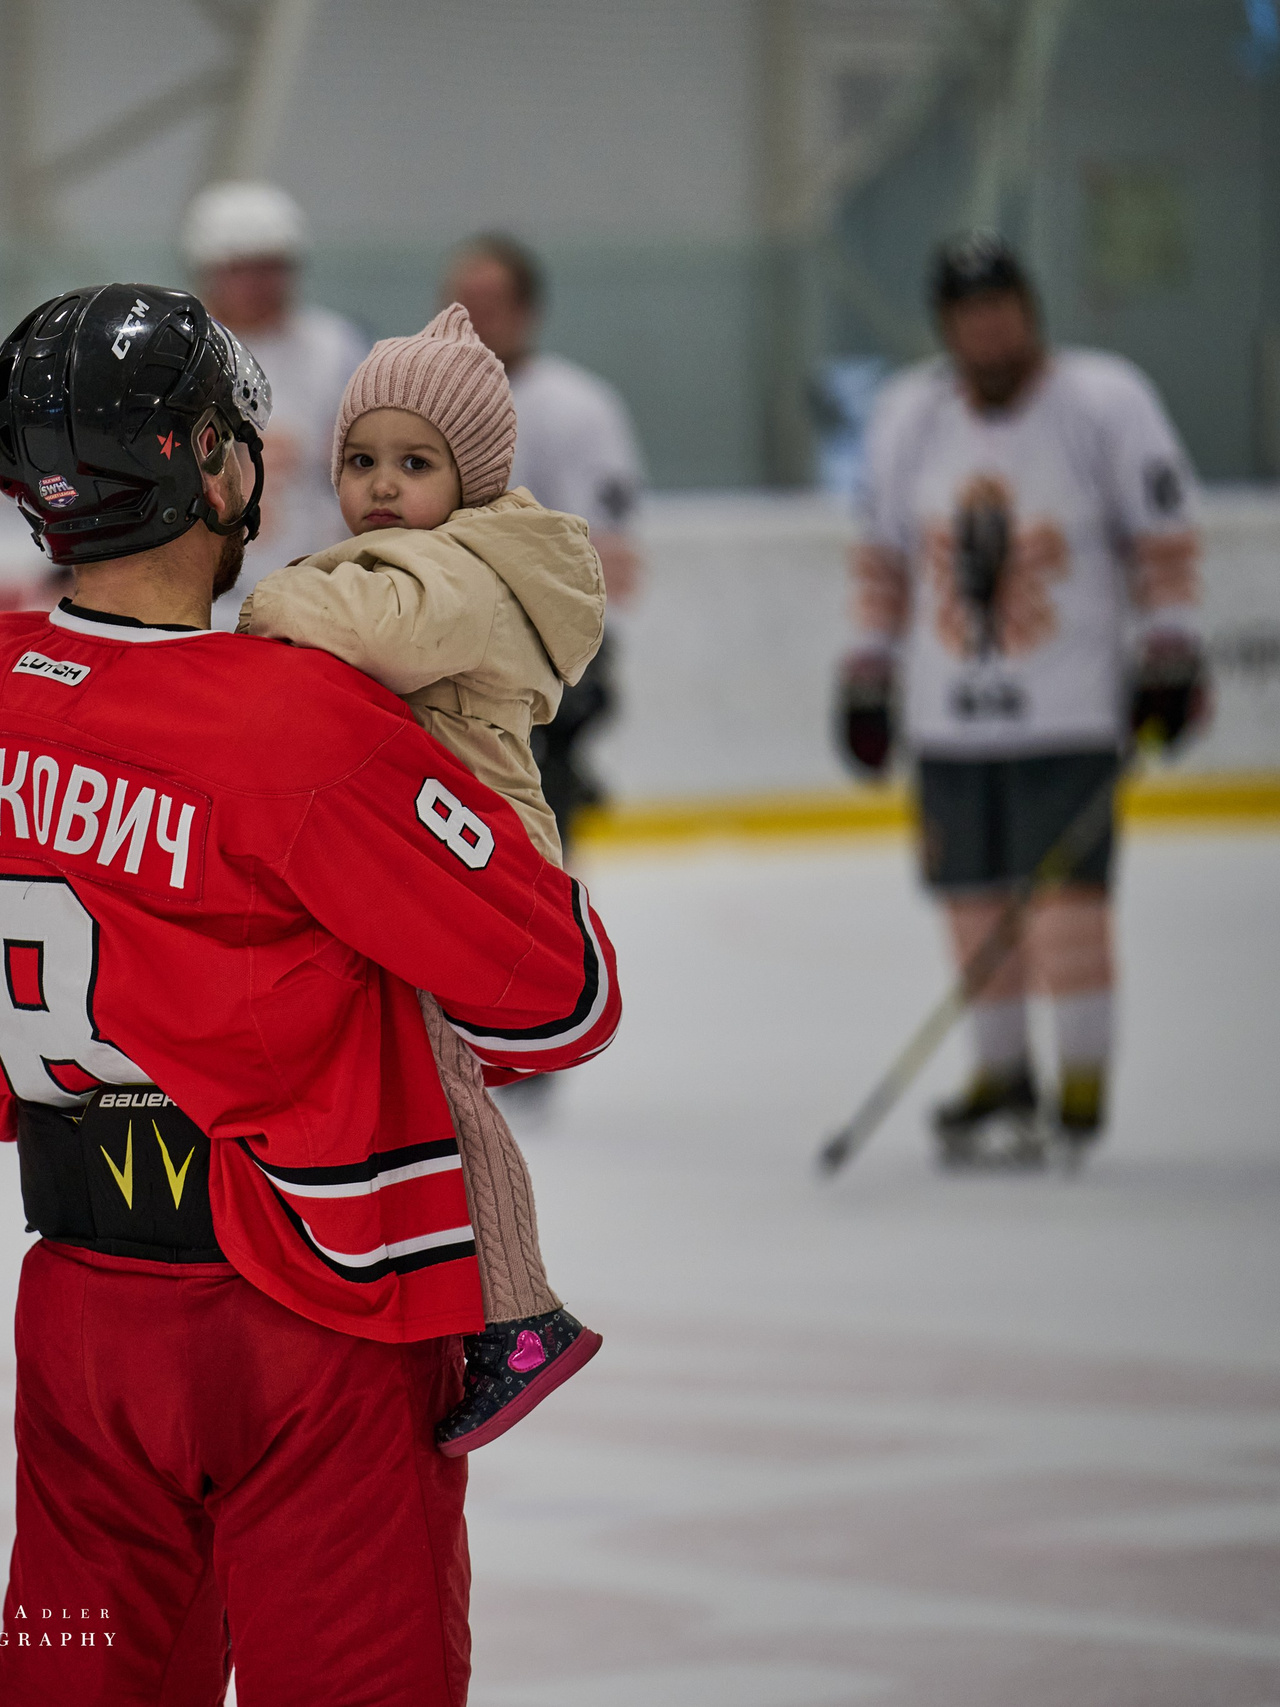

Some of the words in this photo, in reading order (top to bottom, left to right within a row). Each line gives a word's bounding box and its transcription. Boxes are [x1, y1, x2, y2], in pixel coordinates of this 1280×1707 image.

[111, 298, 150, 360] CCM
[41, 481, 74, 497] SWHL
[414, 776, 496, 871] 8
